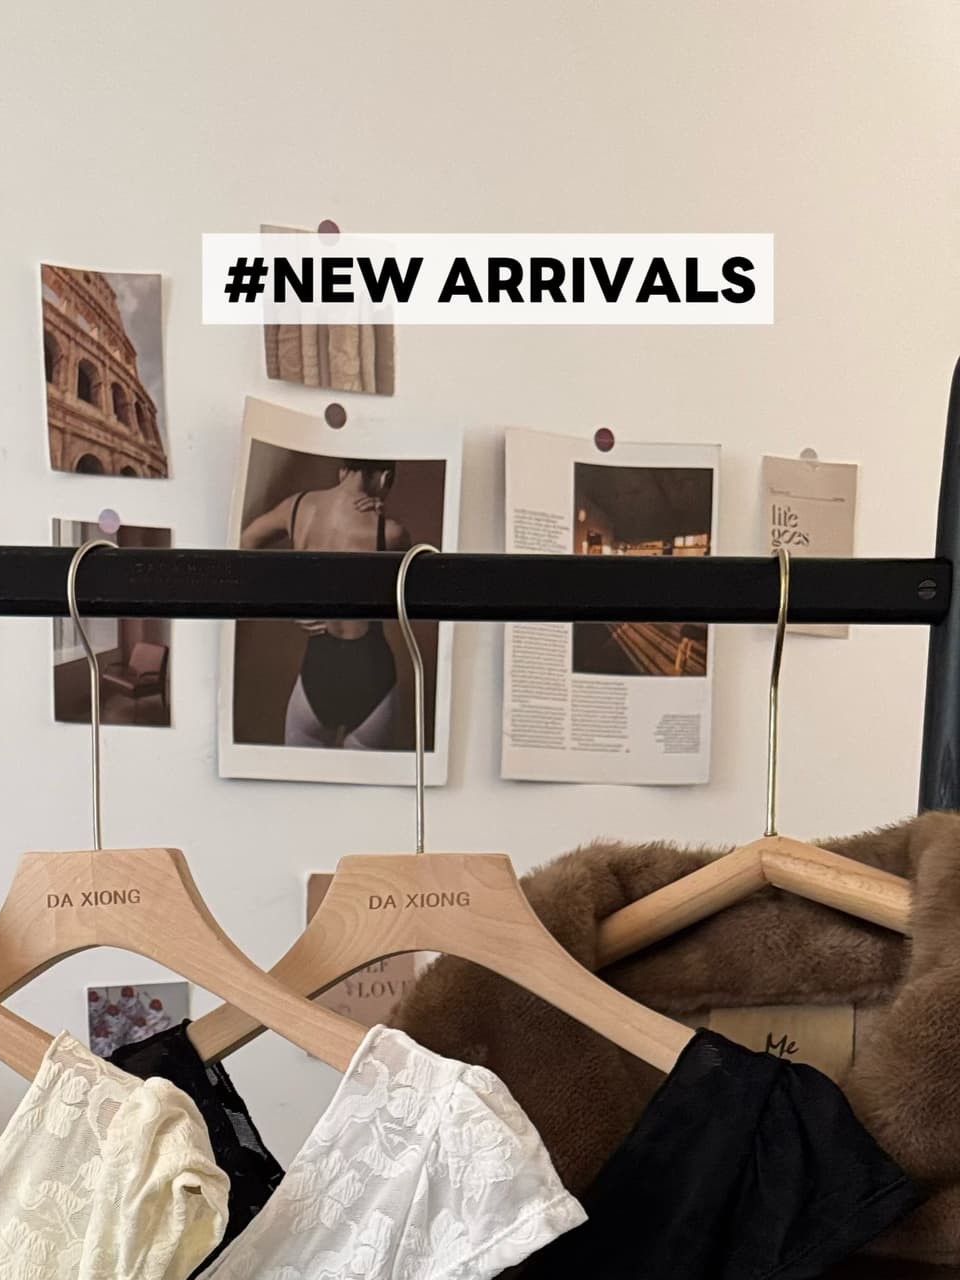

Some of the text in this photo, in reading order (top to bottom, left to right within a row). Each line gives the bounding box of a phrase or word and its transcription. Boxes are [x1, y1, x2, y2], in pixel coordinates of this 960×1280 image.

[47, 889, 141, 909] DA XIONG
[369, 891, 470, 910] DA XIONG
